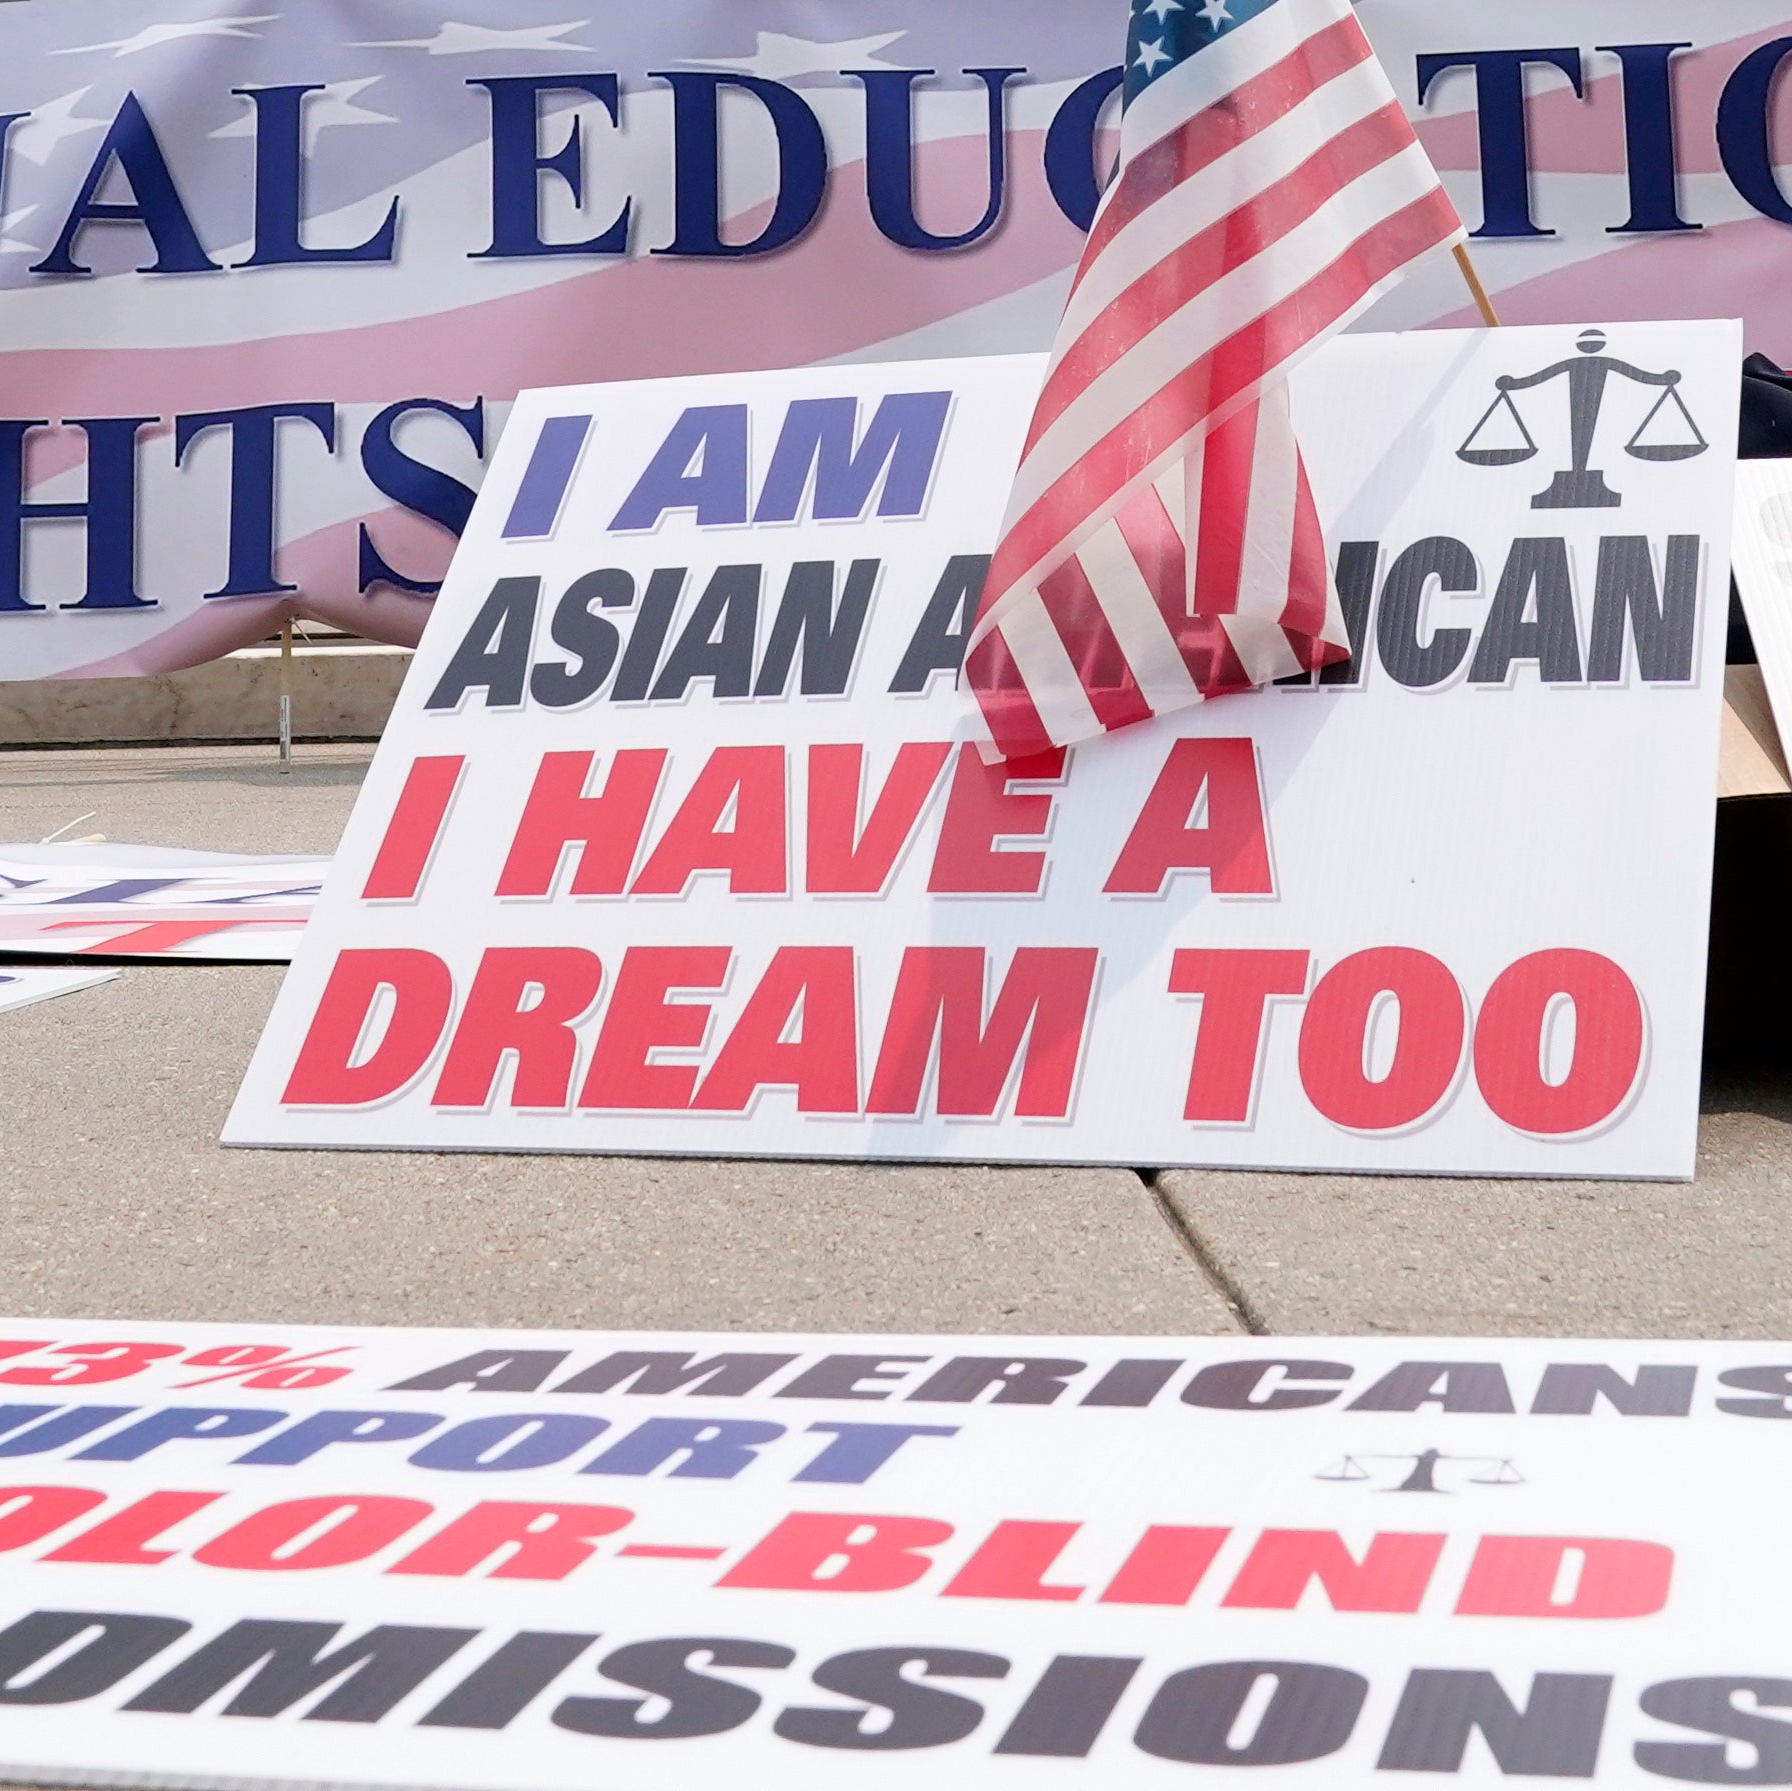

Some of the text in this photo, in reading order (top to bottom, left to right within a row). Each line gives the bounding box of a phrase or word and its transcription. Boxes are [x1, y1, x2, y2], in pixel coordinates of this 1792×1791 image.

[499, 391, 954, 540] I AM
[426, 558, 857, 710] ASIAN
[362, 737, 1275, 900] I HAVE A
[280, 946, 1646, 1136] DREAM TOO
